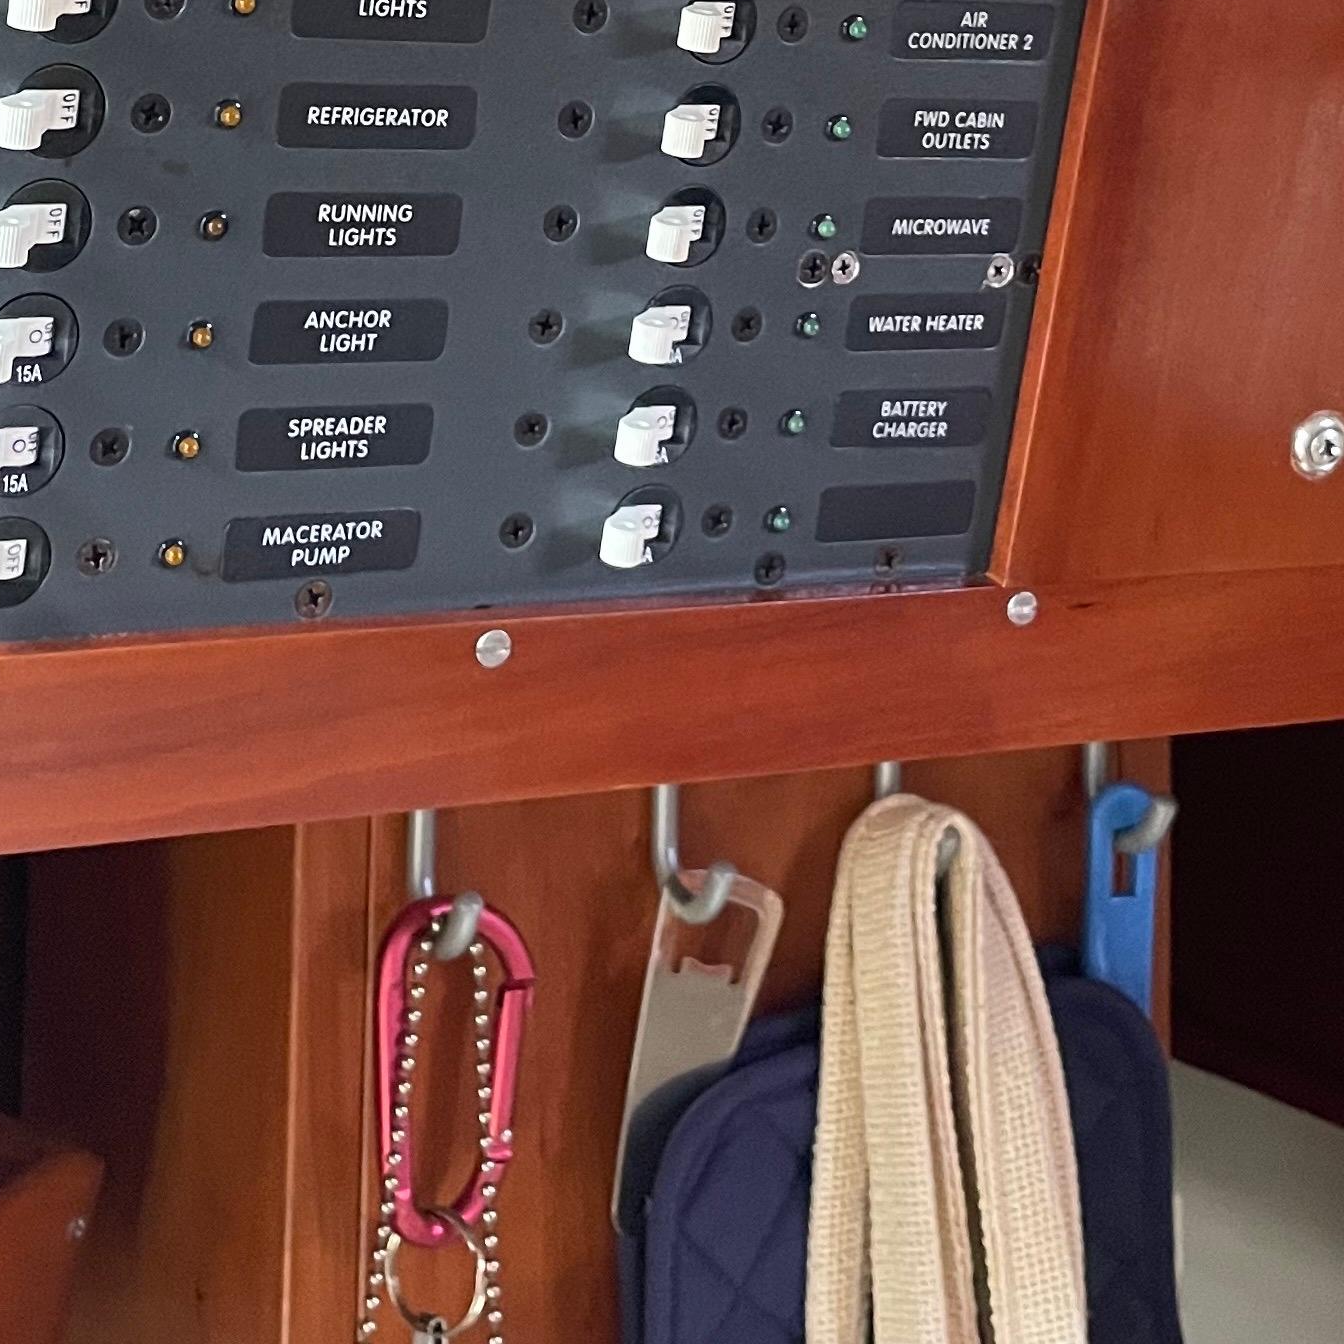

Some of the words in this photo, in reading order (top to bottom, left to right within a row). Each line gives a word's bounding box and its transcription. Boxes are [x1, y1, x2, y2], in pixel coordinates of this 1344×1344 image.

[960, 11, 988, 28] AIR
[907, 32, 1019, 50] CONDITIONER
[1022, 34, 1034, 51] 2
[61, 92, 76, 124] OFF
[307, 106, 449, 128] REFRIGERATOR
[913, 110, 951, 128] FWD
[955, 111, 1005, 128] CABIN
[921, 132, 990, 150] OUTLETS
[47, 207, 62, 238] OFF
[317, 203, 414, 224] RUNNING
[328, 227, 397, 247] LIGHTS
[891, 218, 991, 236] MICROWAVE
[303, 309, 392, 330] ANCHOR
[868, 315, 922, 333] WATER
[925, 314, 985, 332] HEATER
[319, 332, 378, 352] LIGHT
[16, 364, 42, 383] 15A
[881, 400, 949, 418] BATTERY
[288, 416, 387, 438] SPREADER
[872, 421, 949, 439] CHARGER
[300, 439, 369, 460] LIGHTS
[3, 474, 28, 492] 15A
[261, 520, 384, 547] MACERATOR
[6, 543, 22, 572] OFF
[291, 546, 351, 567] PUMP
